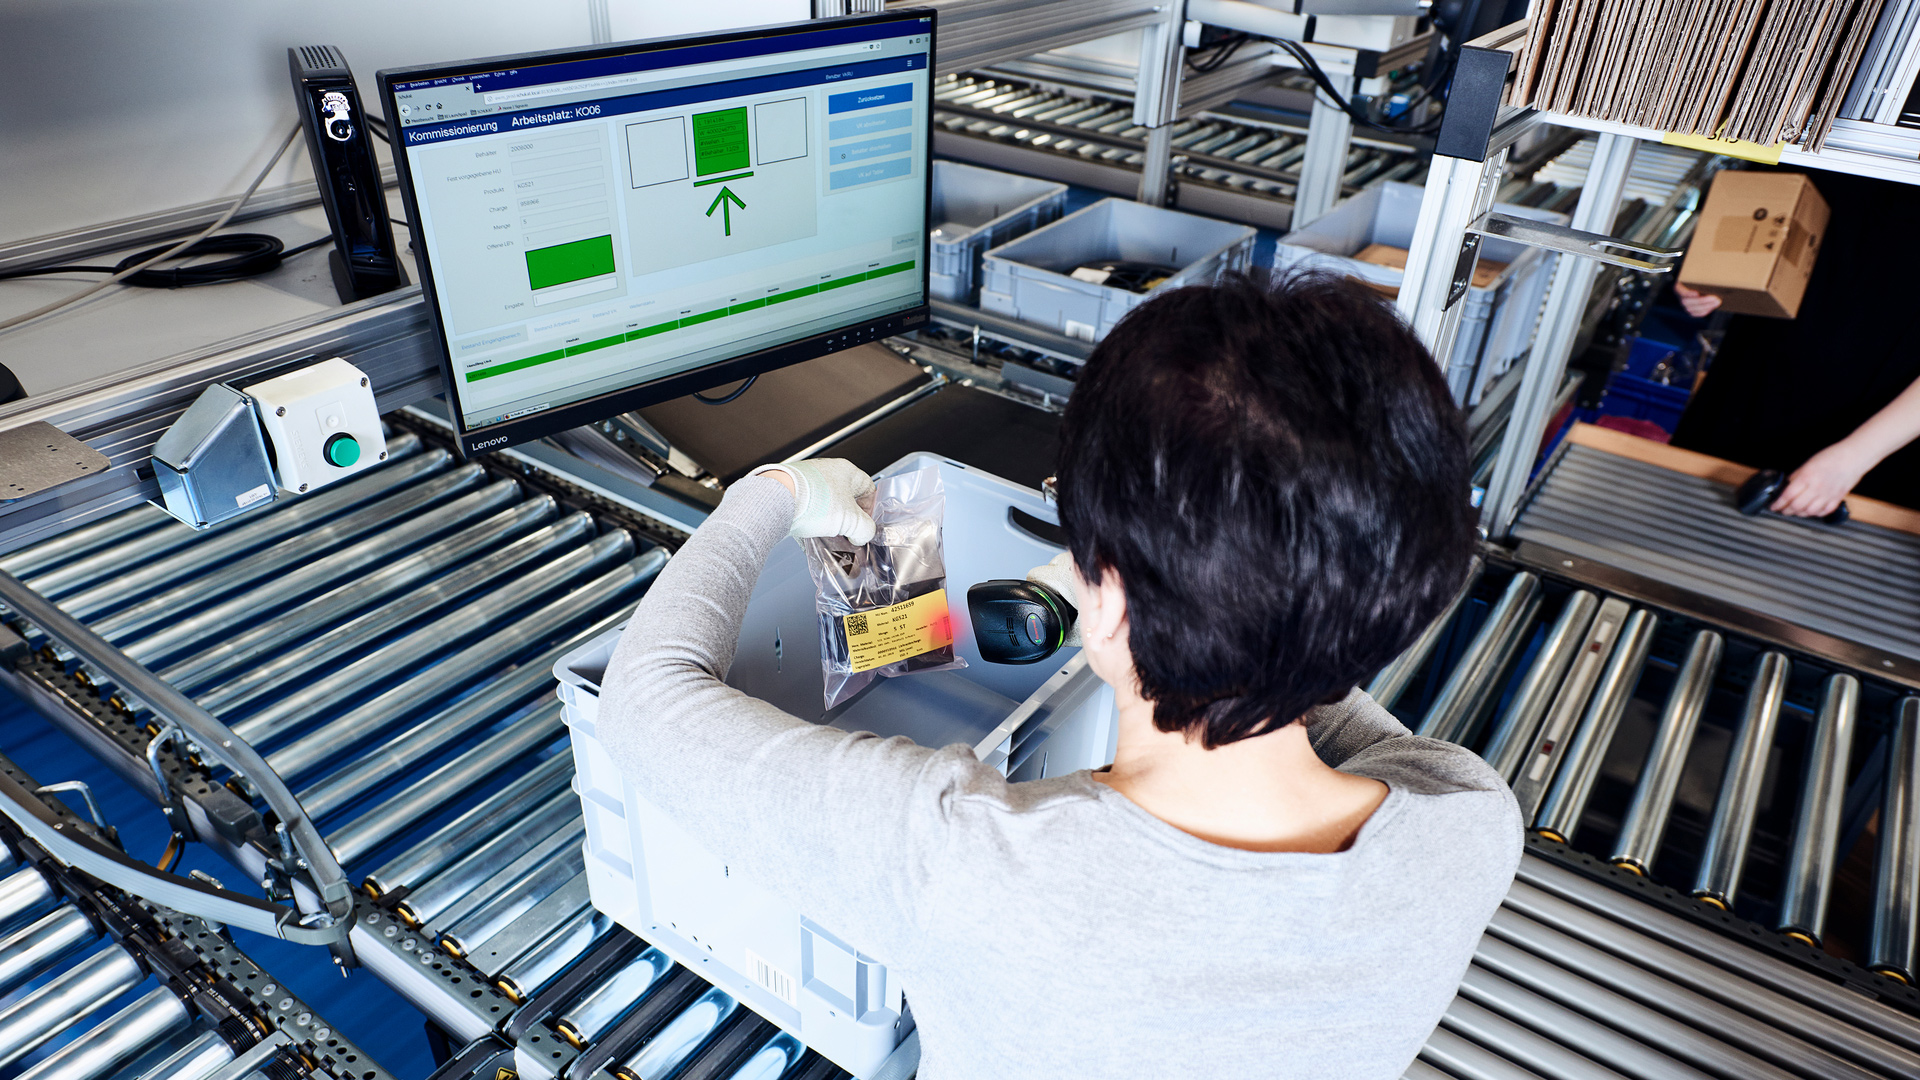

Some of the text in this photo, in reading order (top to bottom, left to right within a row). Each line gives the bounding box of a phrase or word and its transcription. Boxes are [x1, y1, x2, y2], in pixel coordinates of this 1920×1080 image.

[408, 121, 498, 142] Kommissionierung
[511, 109, 574, 127] Arbeitsplatz:
[290, 429, 308, 469] SIEMENS
[471, 435, 508, 452] Lenovo
